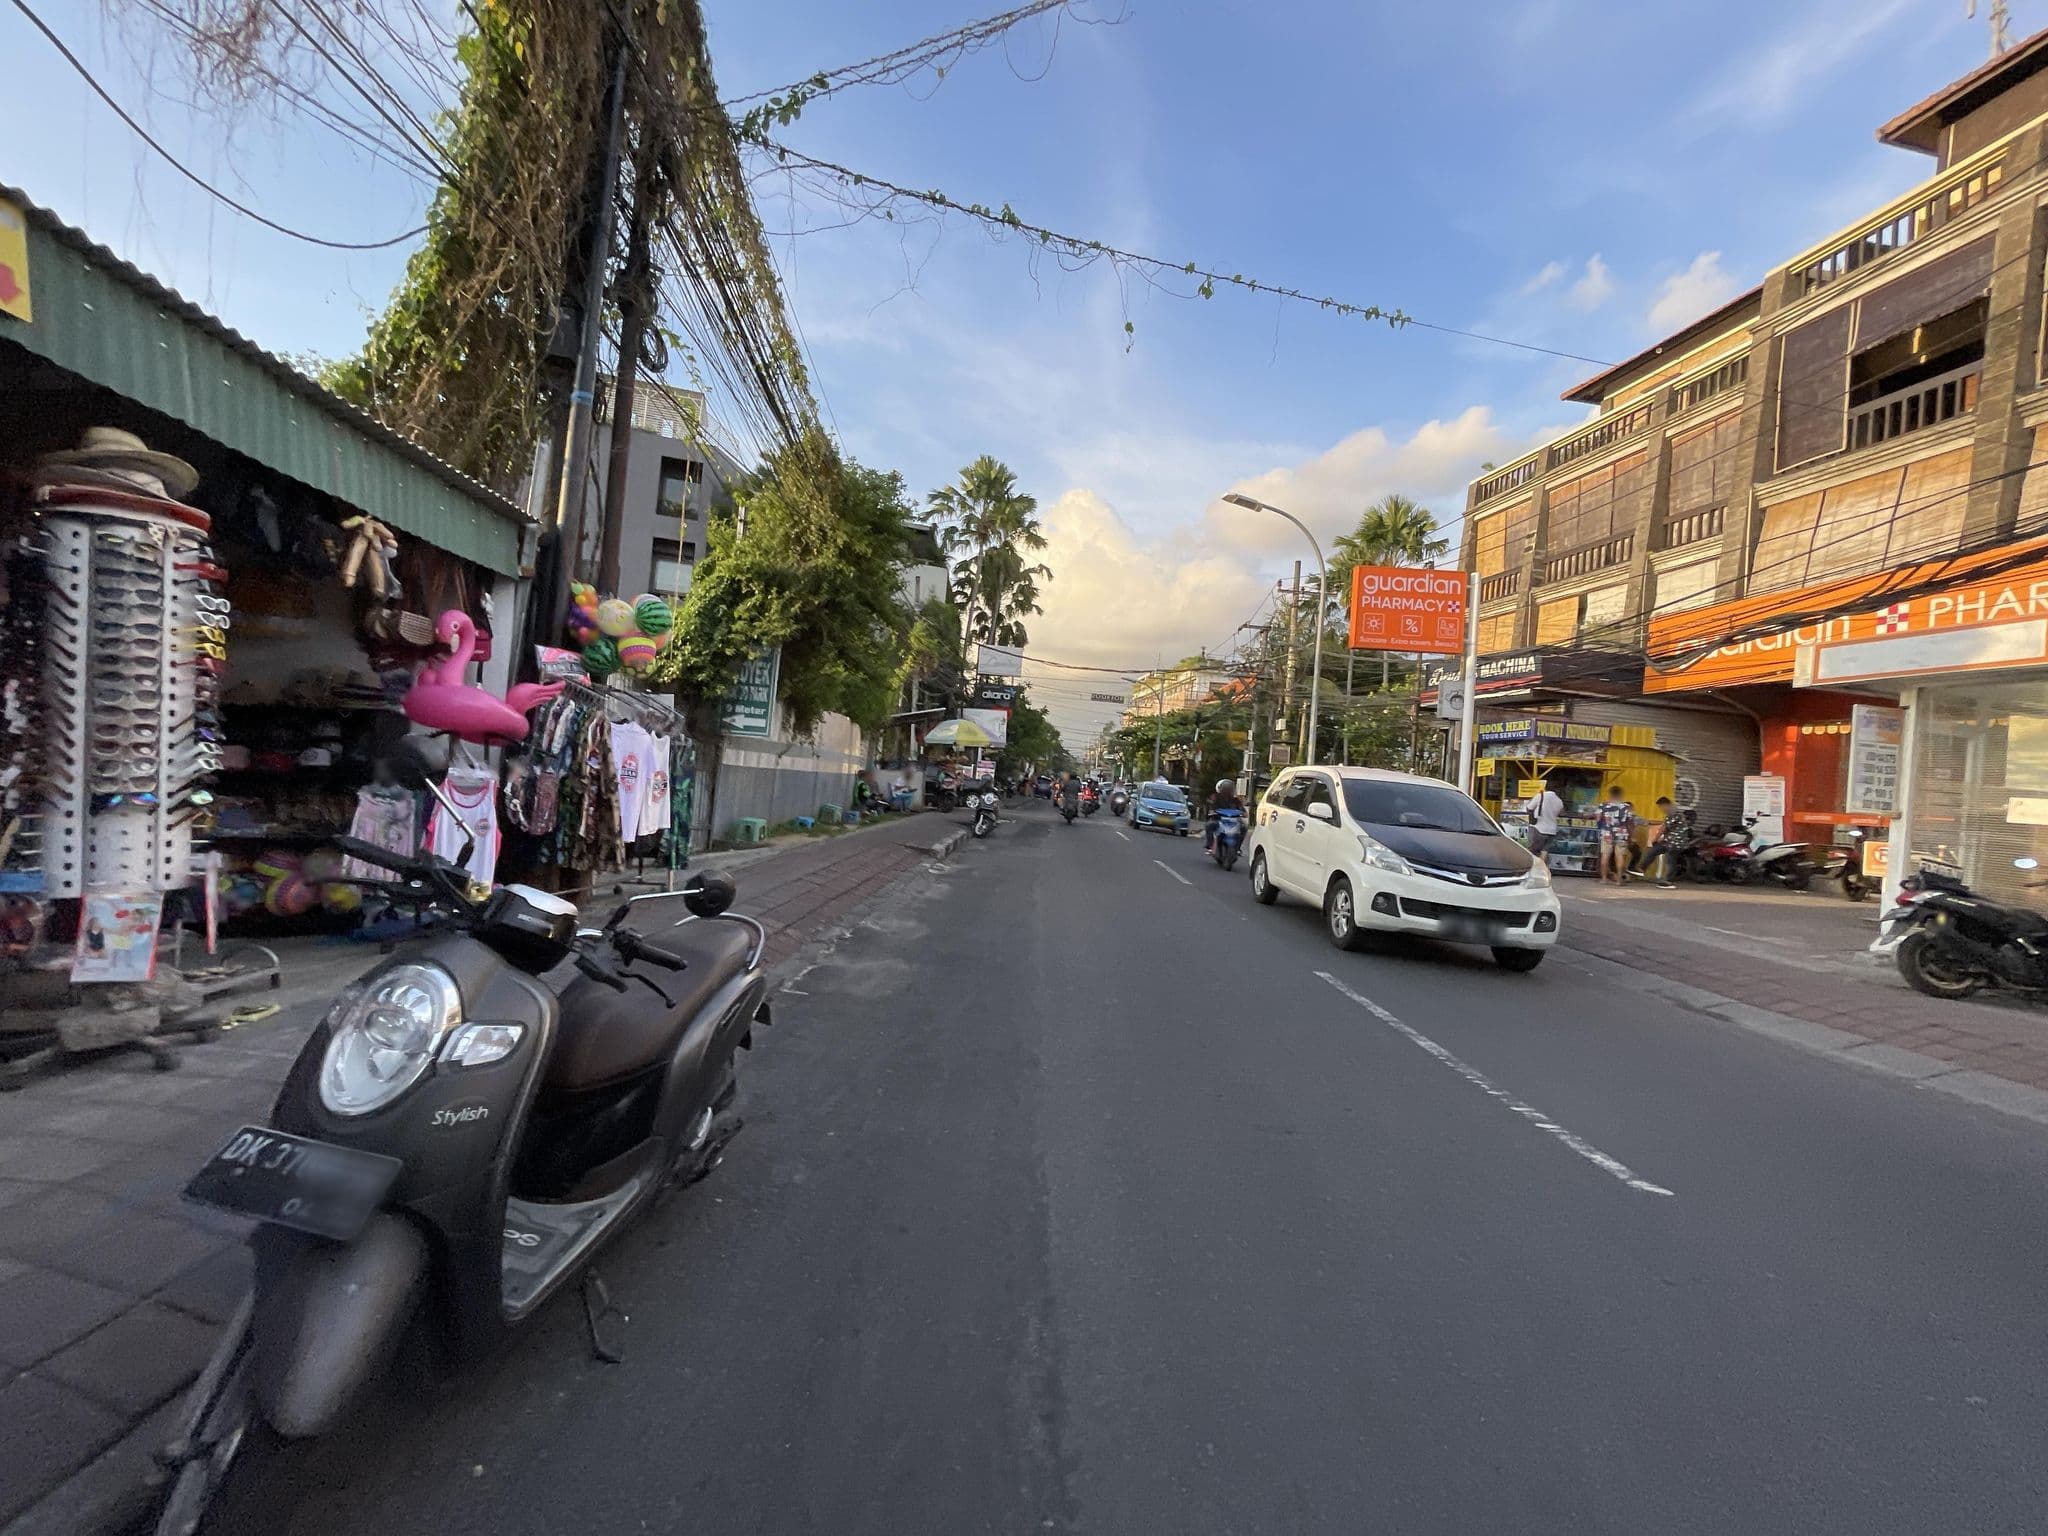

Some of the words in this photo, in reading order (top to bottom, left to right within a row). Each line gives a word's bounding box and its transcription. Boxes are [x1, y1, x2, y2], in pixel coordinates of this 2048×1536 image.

[1363, 574, 1461, 595] guardian
[1361, 595, 1445, 611] PHARMACY
[1480, 656, 1536, 678] MACHINA
[735, 704, 767, 715] Meter
[1499, 730, 1529, 739] SERVICE
[1506, 720, 1532, 731] HERE
[431, 1105, 489, 1127] Stylish
[221, 1133, 275, 1167] DK
